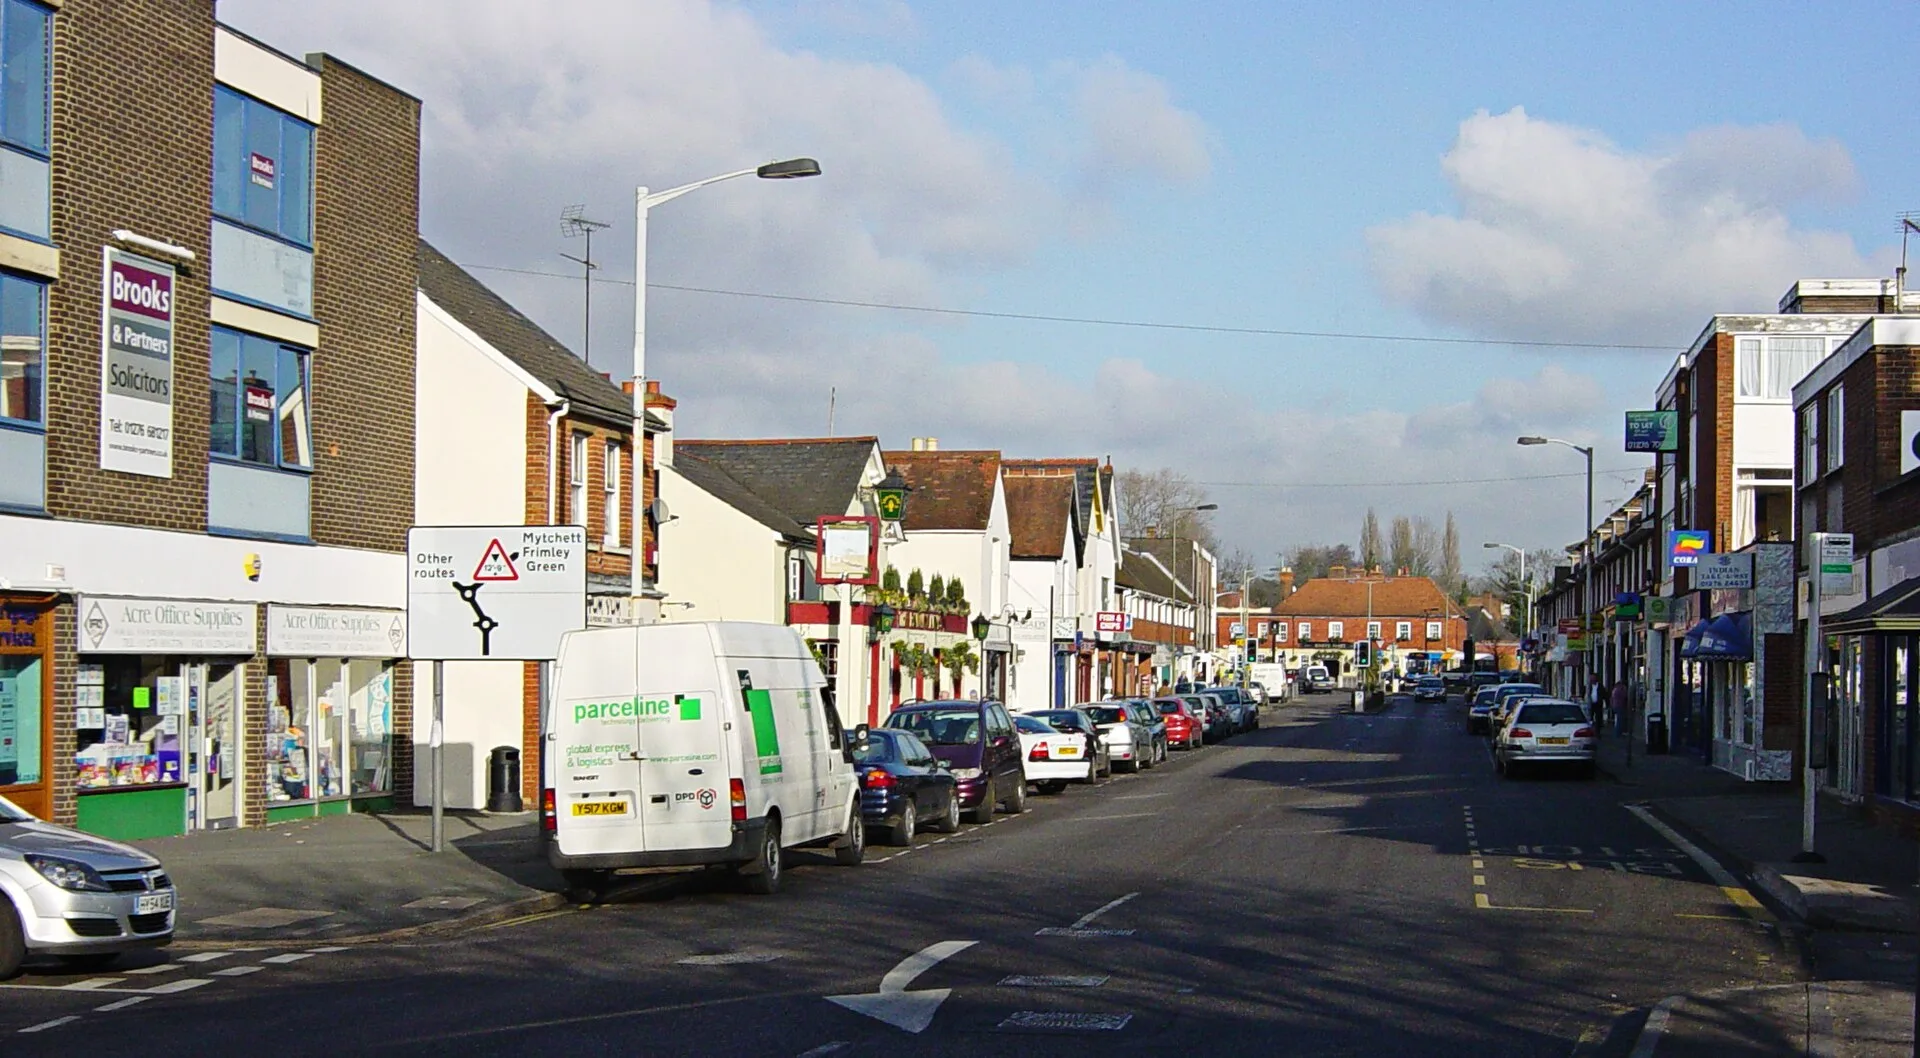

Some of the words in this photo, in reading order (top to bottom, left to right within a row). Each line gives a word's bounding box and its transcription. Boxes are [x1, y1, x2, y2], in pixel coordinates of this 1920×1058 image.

[113, 271, 170, 312] Brooks
[113, 324, 122, 343] &
[124, 326, 168, 354] Partners
[110, 363, 169, 396] Solicitors
[523, 532, 582, 545] Mytchett
[416, 553, 453, 564] Other
[523, 546, 570, 559] Frimley
[526, 561, 566, 572] Green
[414, 568, 455, 579] routes
[121, 605, 151, 623] Acre
[154, 605, 190, 626] Office
[193, 607, 243, 630] Supplies
[282, 612, 307, 629] Acre
[309, 612, 338, 630] Office
[340, 614, 381, 634] Supplies
[1099, 614, 1115, 622] FISH
[1115, 614, 1122, 622] &
[1100, 622, 1121, 630] CHIPS
[574, 696, 670, 724] parceline
[565, 744, 593, 756] global
[595, 744, 631, 755] express
[567, 758, 574, 768] &
[576, 757, 613, 769] logistics
[675, 792, 695, 801] DPD
[577, 803, 600, 814] Y517
[602, 802, 624, 813] KGM
